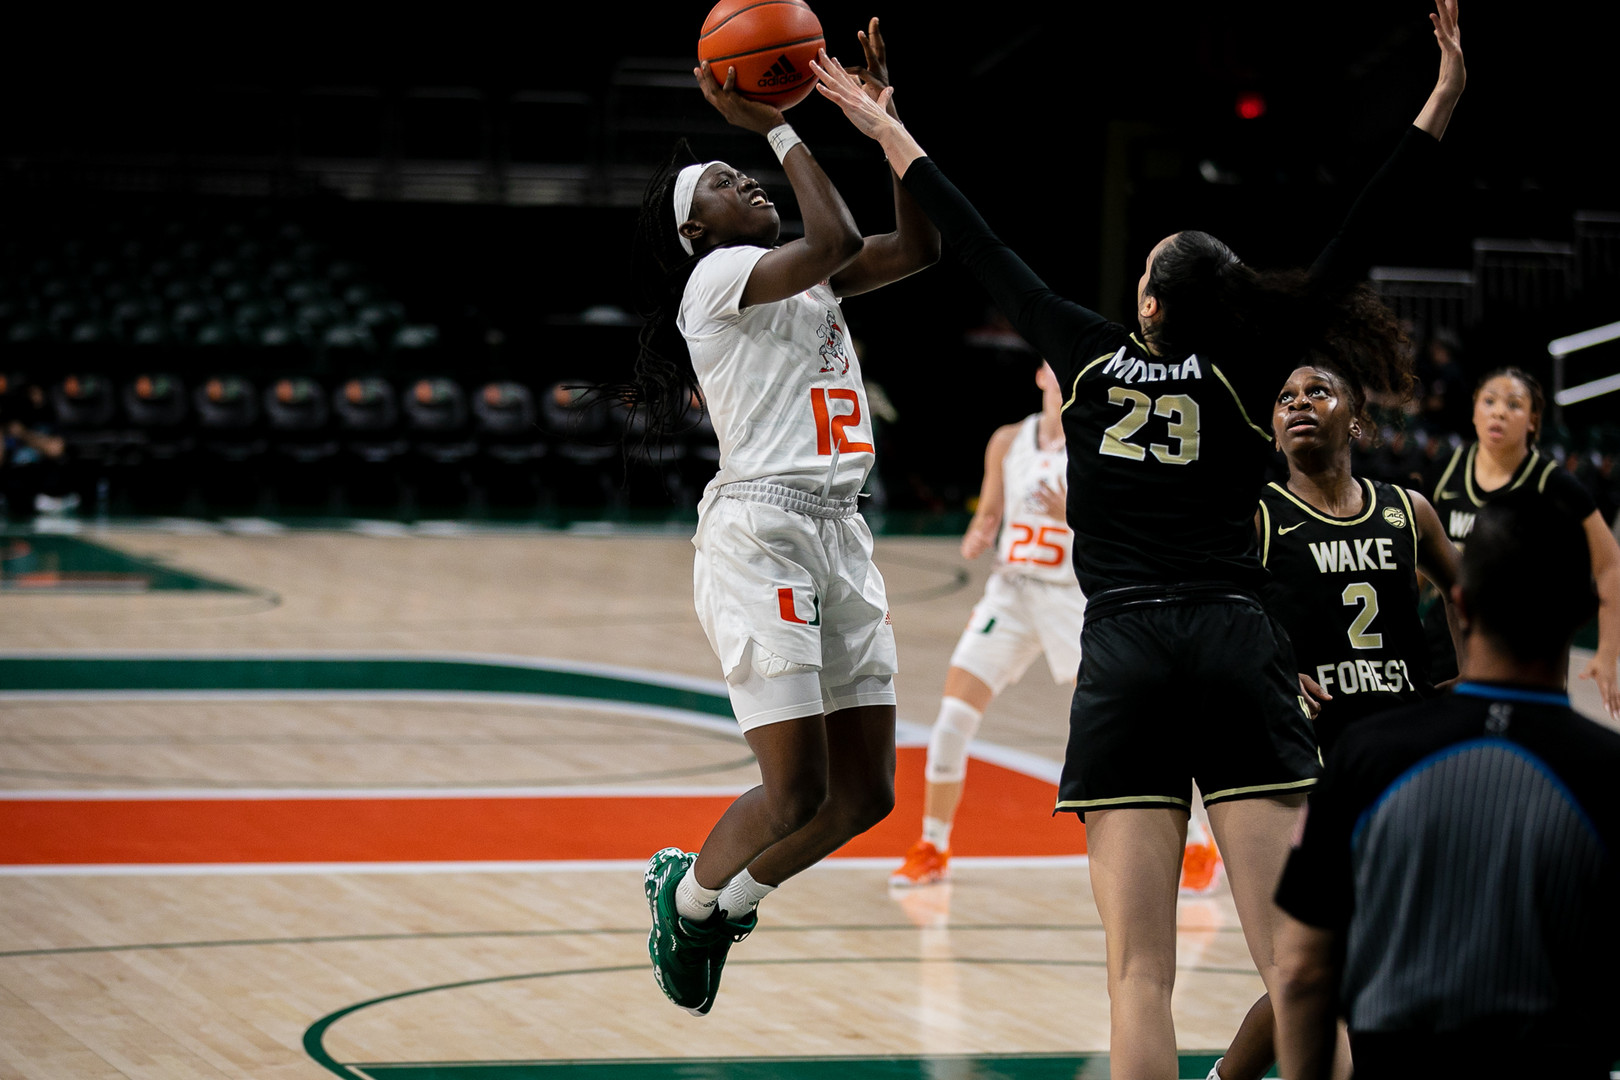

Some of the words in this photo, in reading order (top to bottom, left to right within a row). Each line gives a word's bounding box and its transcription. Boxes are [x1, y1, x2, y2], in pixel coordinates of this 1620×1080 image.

[811, 388, 875, 456] 12
[1099, 386, 1200, 465] 23
[1009, 523, 1068, 566] 25
[1308, 538, 1398, 573] WAKE
[1341, 582, 1383, 650] 2
